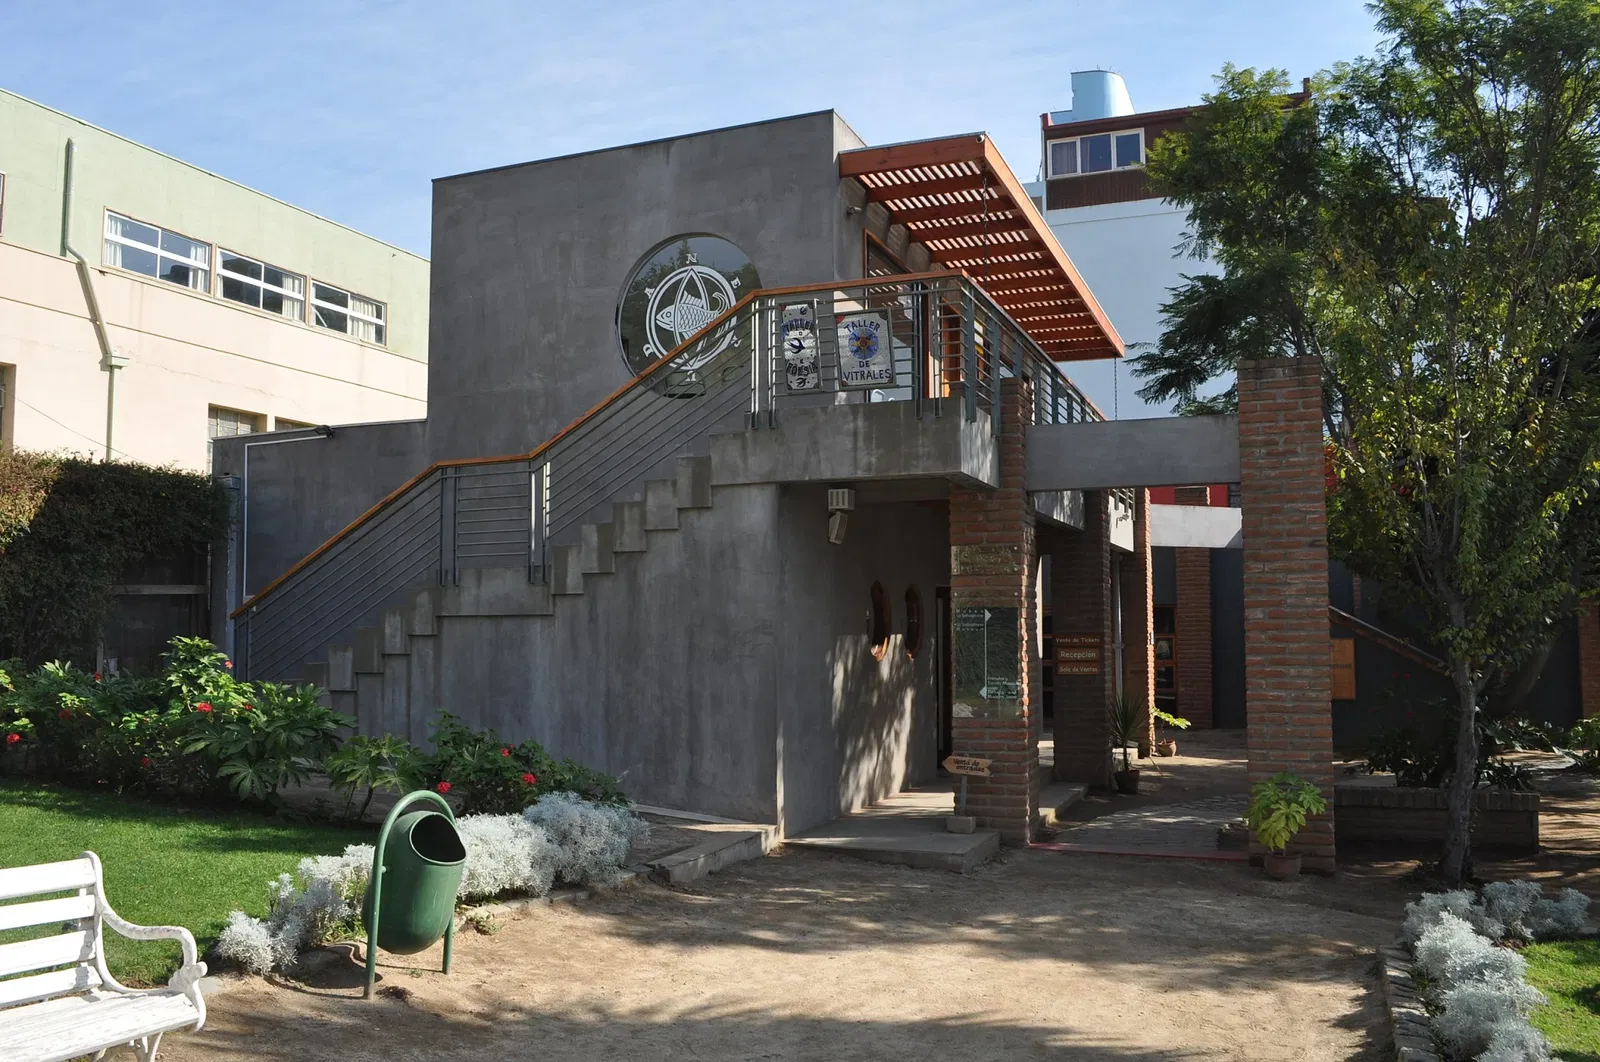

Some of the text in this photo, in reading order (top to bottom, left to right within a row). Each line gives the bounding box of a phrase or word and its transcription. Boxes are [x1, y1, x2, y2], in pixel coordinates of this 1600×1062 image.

[844, 320, 881, 333] TALLER
[859, 360, 870, 368] DE
[843, 369, 892, 381] VITRALES
[1060, 650, 1096, 659] Recepción
